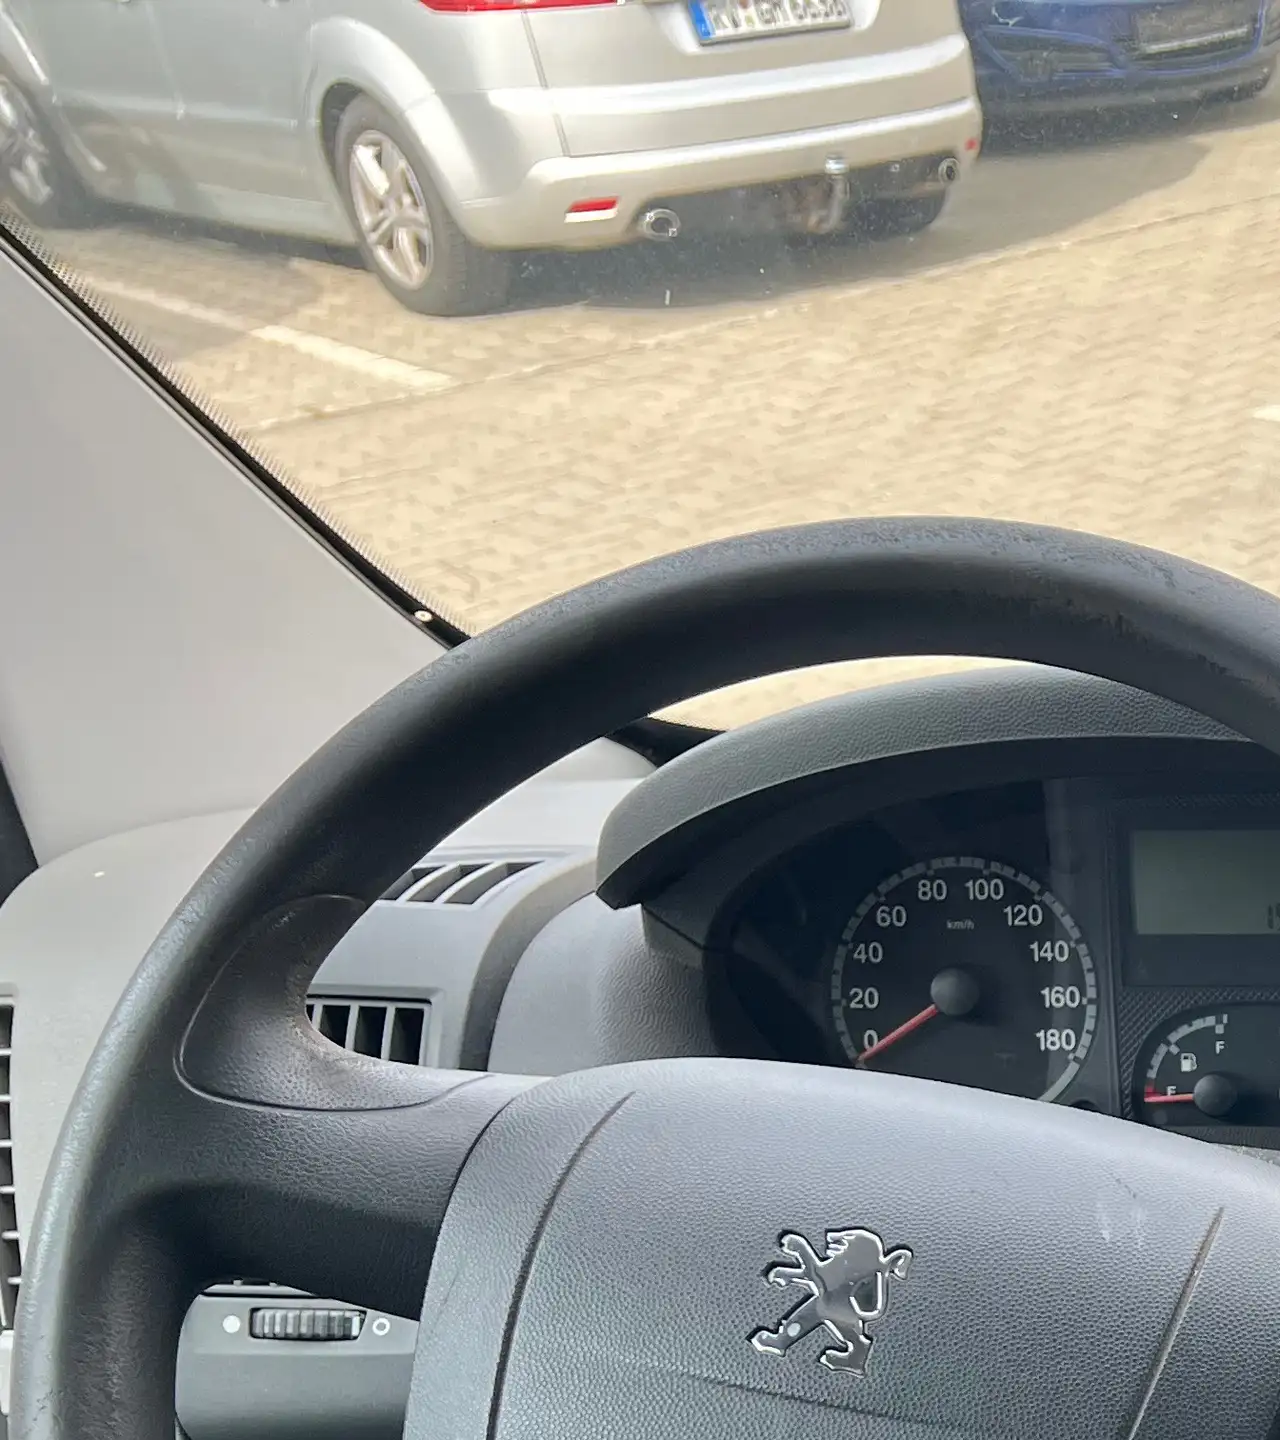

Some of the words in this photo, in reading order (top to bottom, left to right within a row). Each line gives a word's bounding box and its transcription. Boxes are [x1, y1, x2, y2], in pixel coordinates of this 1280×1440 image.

[918, 879, 948, 901] 80
[964, 878, 1004, 901] 100
[876, 905, 907, 927] 60
[946, 919, 975, 931] km/h
[1003, 904, 1043, 926] 120
[853, 941, 883, 963] 40
[1029, 940, 1069, 962] 140
[850, 987, 879, 1009] 20
[1040, 985, 1080, 1008] 160
[863, 1029, 879, 1050] 0
[1035, 1029, 1075, 1051] 180
[1215, 1040, 1225, 1054] F
